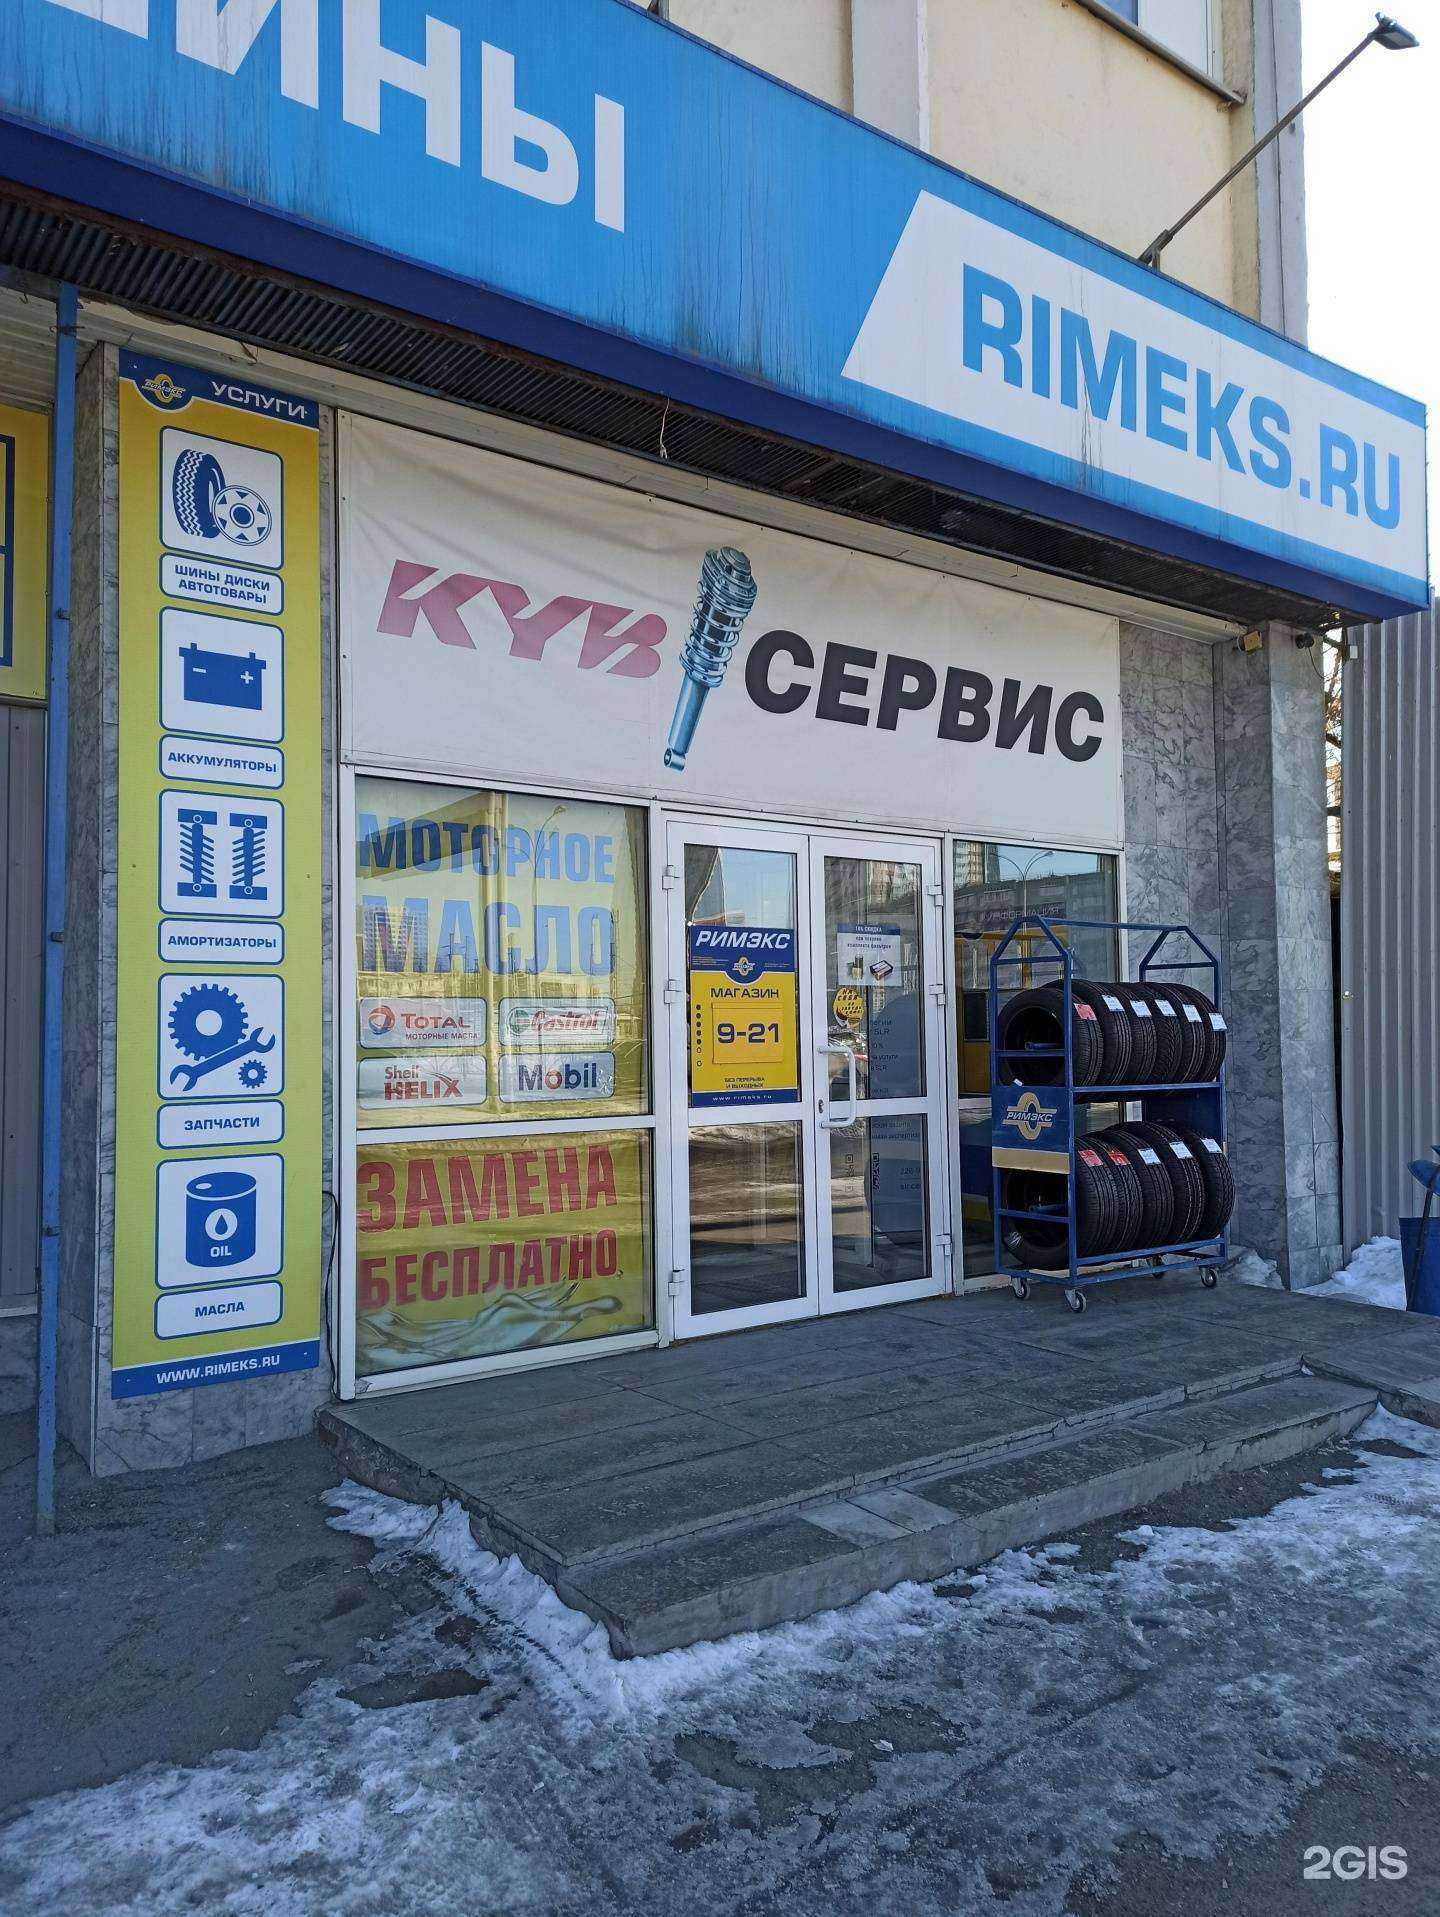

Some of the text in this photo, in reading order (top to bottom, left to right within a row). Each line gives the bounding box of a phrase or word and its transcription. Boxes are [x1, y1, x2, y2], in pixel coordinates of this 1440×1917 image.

[46, 0, 624, 233] ИНЫ
[211, 381, 305, 419] УСЛУГИ
[963, 263, 1400, 530] RIMEKS.RU
[175, 564, 270, 592] ШИНЫ ДИСКИ
[179, 579, 266, 603] АВТОТОВАРЫ
[377, 559, 668, 678] KYB
[745, 629, 1104, 762] СЕРВИС
[168, 752, 277, 773] АККУМУЛЯТОРЫ
[357, 813, 615, 883] МОТОРНОЕ
[168, 935, 277, 948] АМОРТИЗАТОРЫ
[362, 895, 614, 976] МАСЛО
[695, 930, 790, 949] РИМЭКС
[711, 988, 779, 998] МАГАЗИН
[405, 1032, 449, 1040] МОТОРНЫЕ
[717, 1023, 779, 1043] 9-21
[518, 1063, 597, 1090] Mobil
[384, 1080, 463, 1100] HELIX
[184, 1116, 260, 1131] ЗАПЧАСТИ
[1006, 1112, 1053, 1122] РИМЭКС
[357, 1144, 618, 1233] ЗАМЕНА
[210, 1246, 232, 1258] OIL
[358, 1229, 618, 1310] БЕСПЛАТНО
[194, 1302, 245, 1318] МАСЛА
[156, 1355, 281, 1384] WWW.RIMEKS.RU
